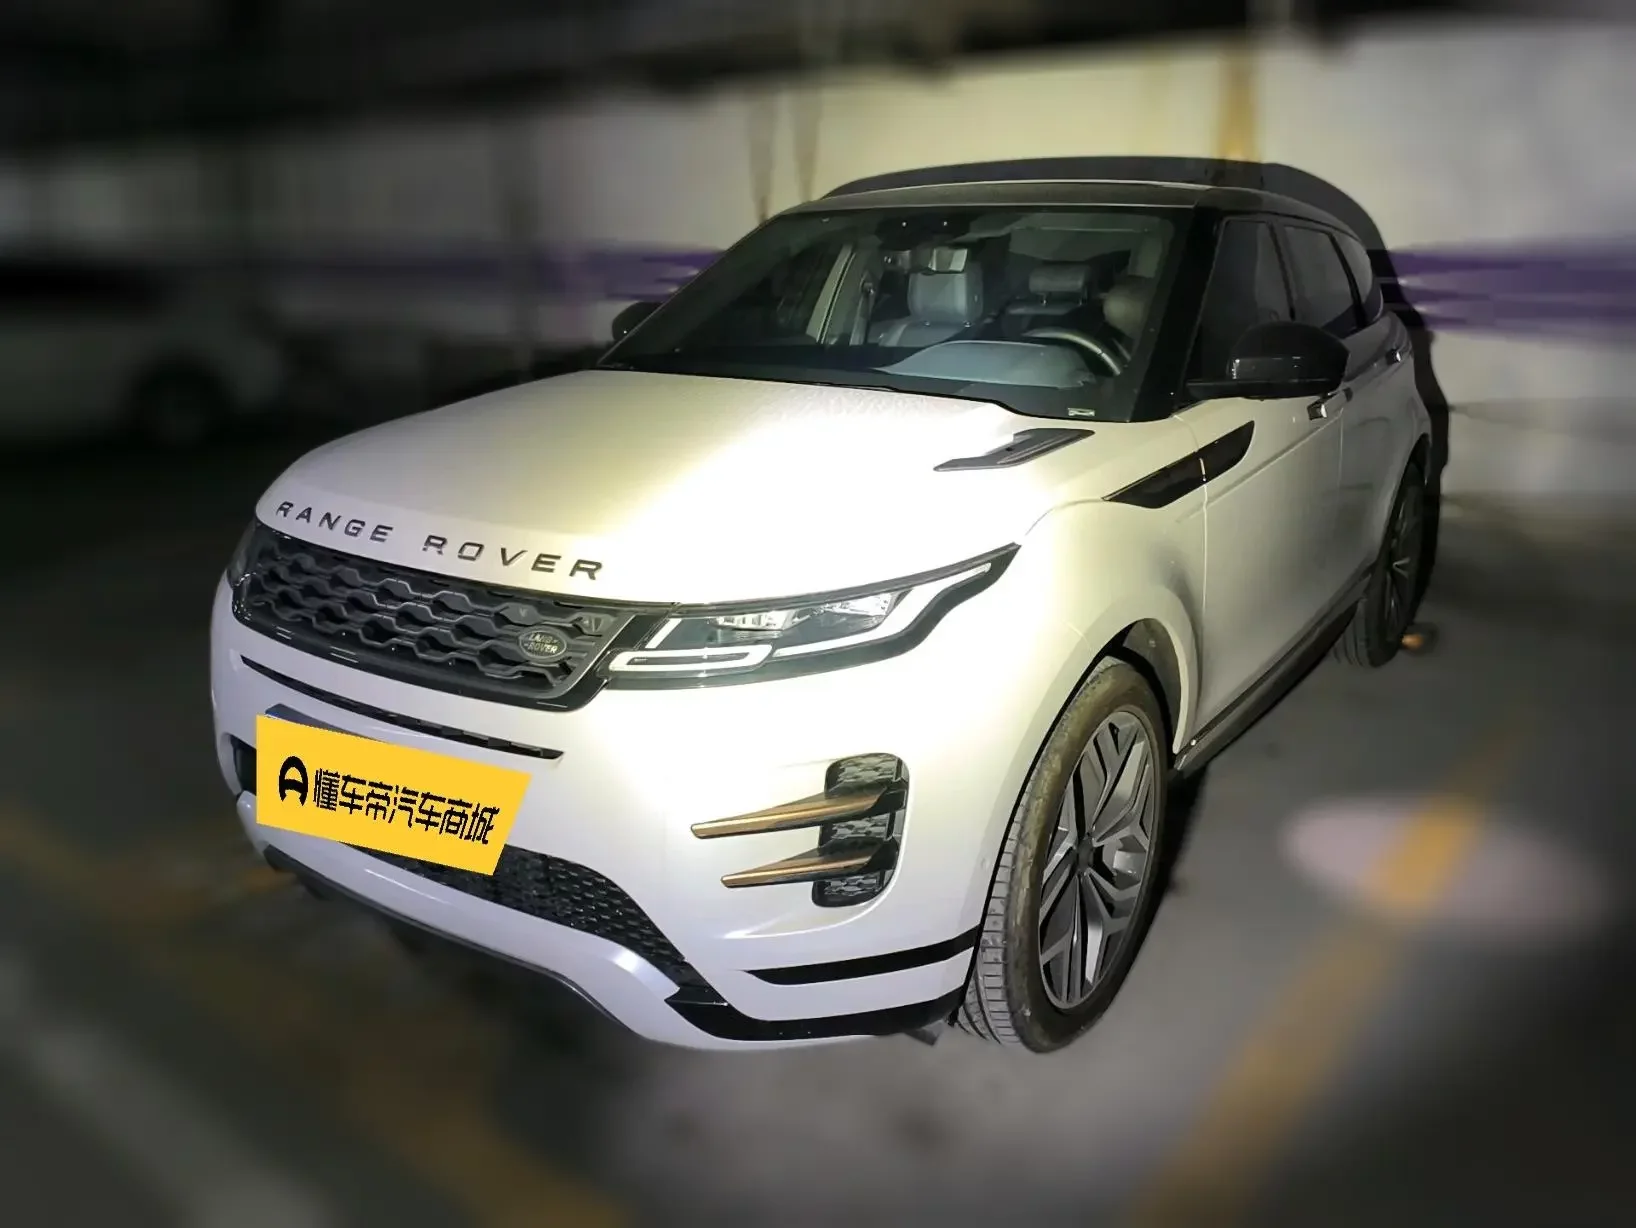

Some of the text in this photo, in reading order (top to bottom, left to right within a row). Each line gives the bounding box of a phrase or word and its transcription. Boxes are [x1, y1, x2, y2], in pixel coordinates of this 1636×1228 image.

[276, 501, 603, 580] RANGE ROVER
[528, 642, 558, 653] ROVER
